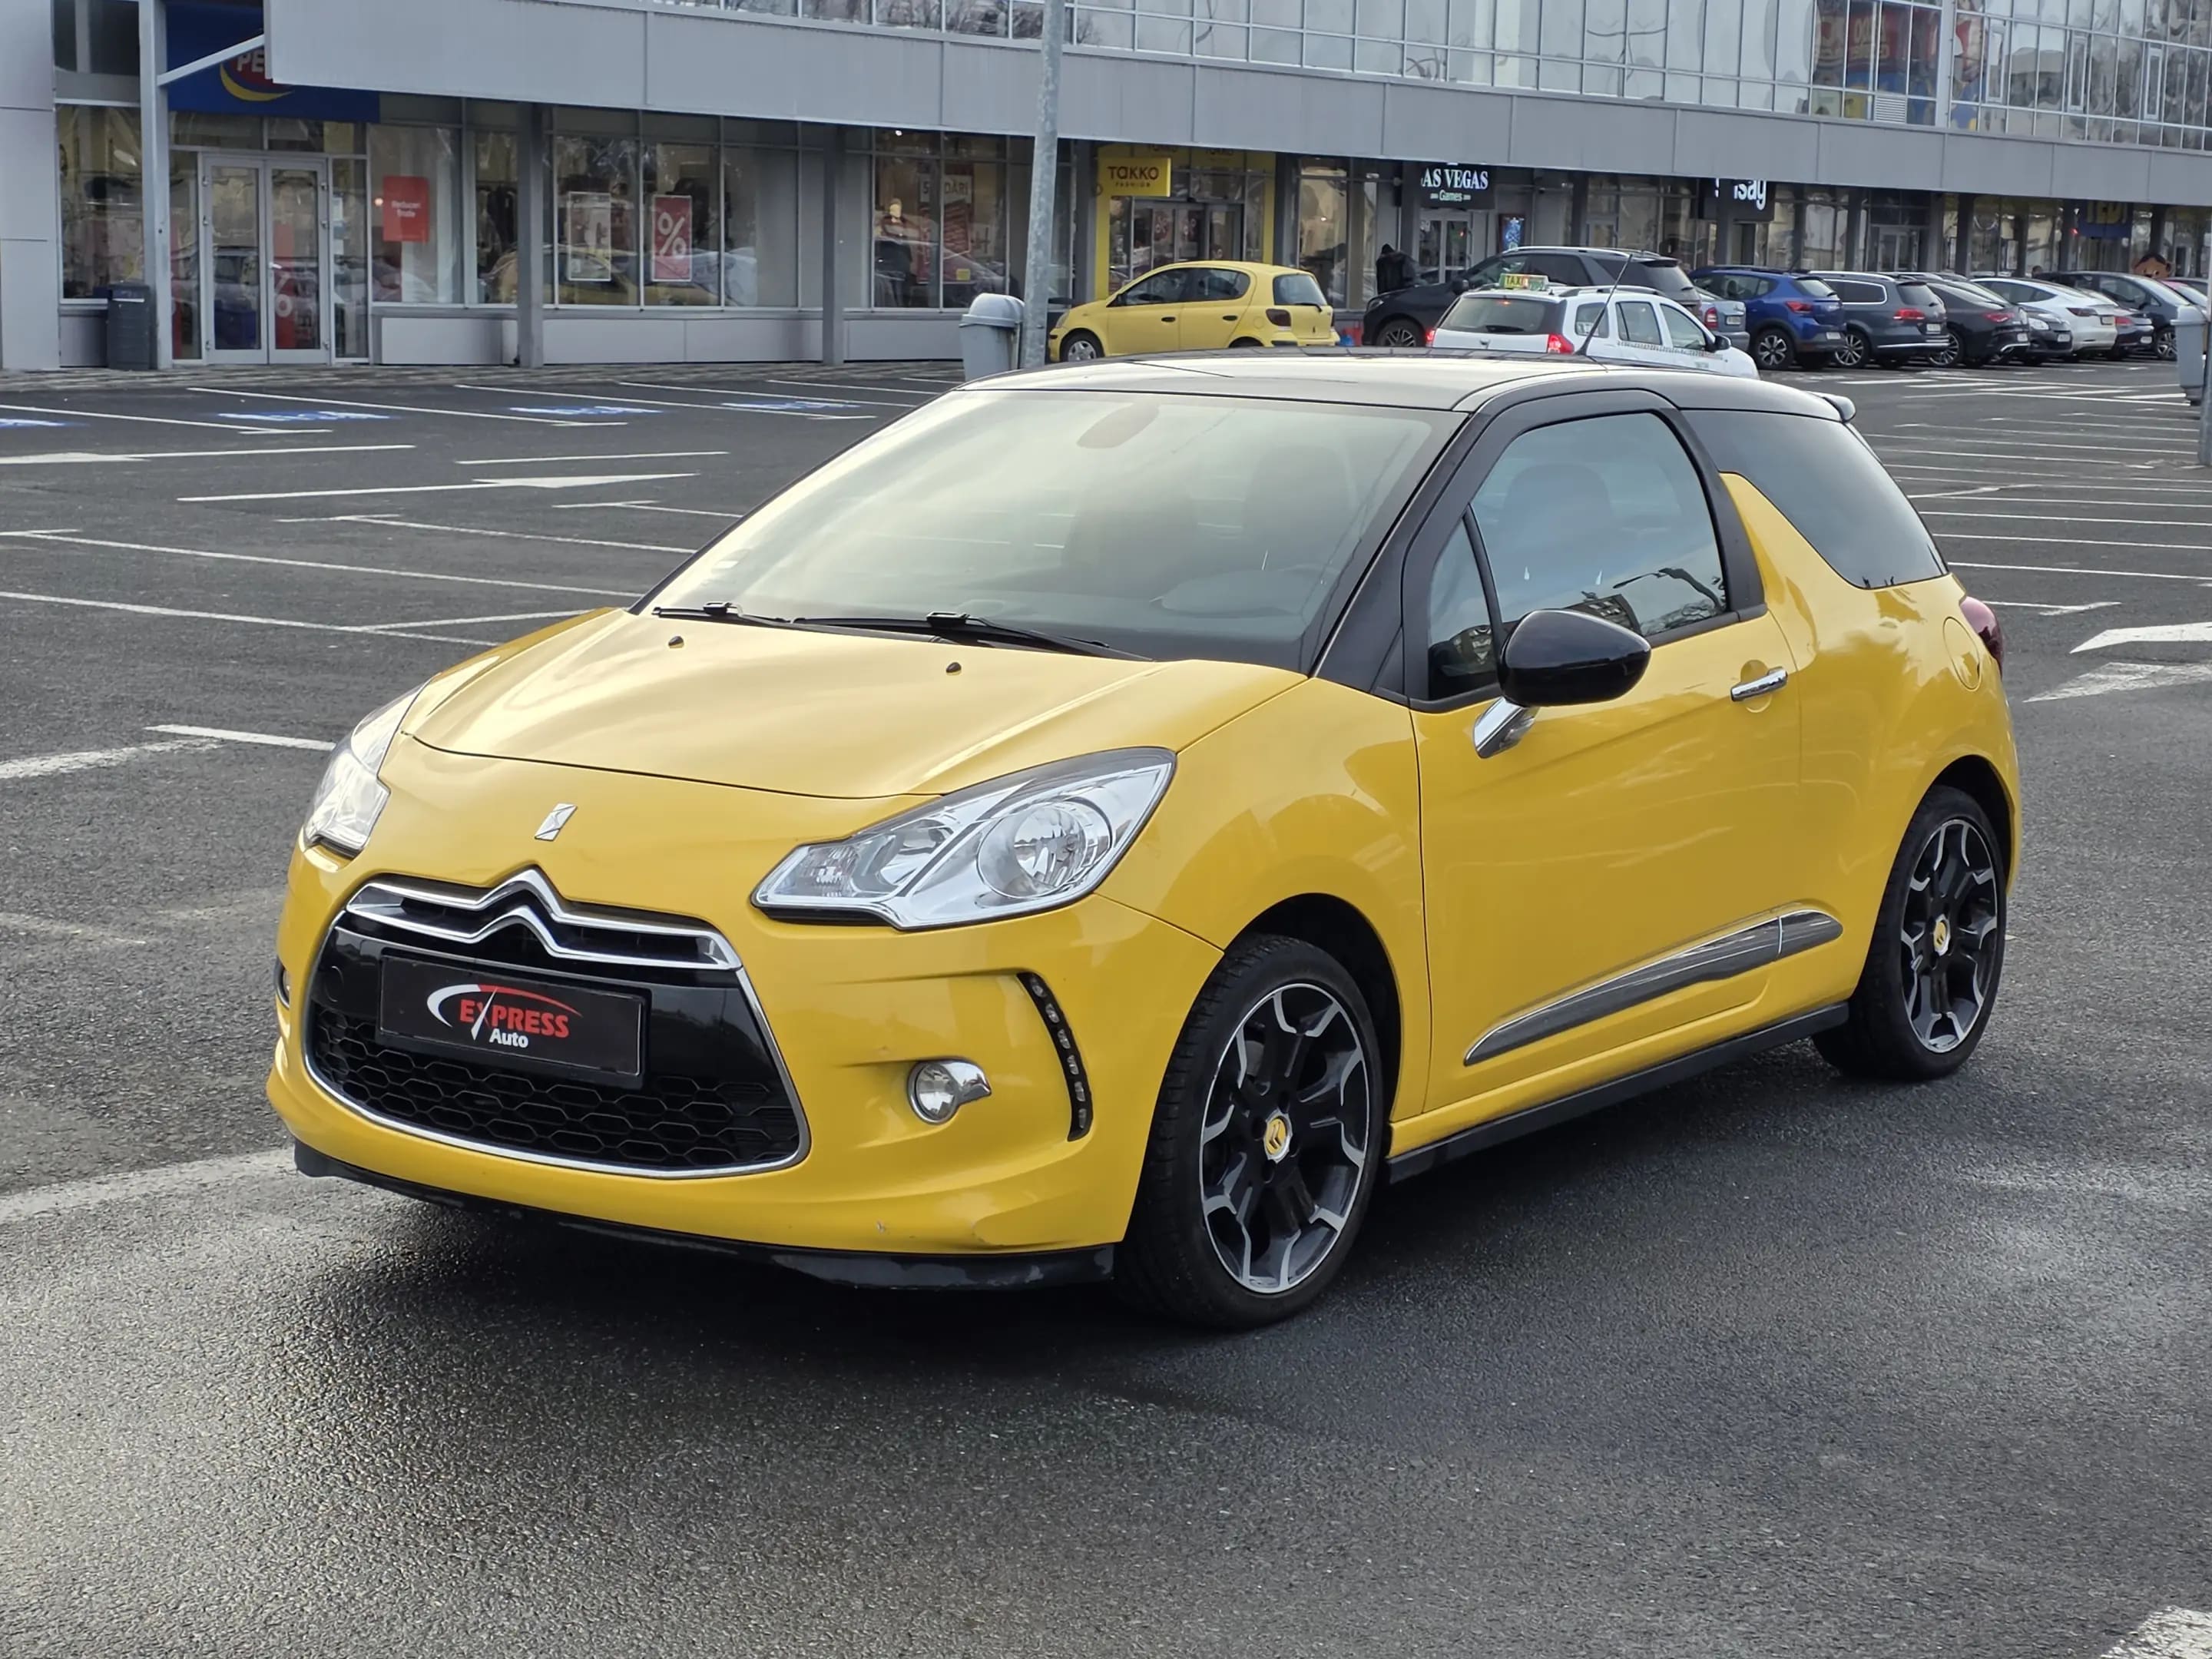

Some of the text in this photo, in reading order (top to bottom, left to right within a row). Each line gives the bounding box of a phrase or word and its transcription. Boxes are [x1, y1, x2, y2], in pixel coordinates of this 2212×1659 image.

[1443, 169, 1488, 190] VEGAS
[1439, 190, 1462, 202] Games
[459, 998, 570, 1038] EXPRESS
[488, 1028, 528, 1049] Auto
